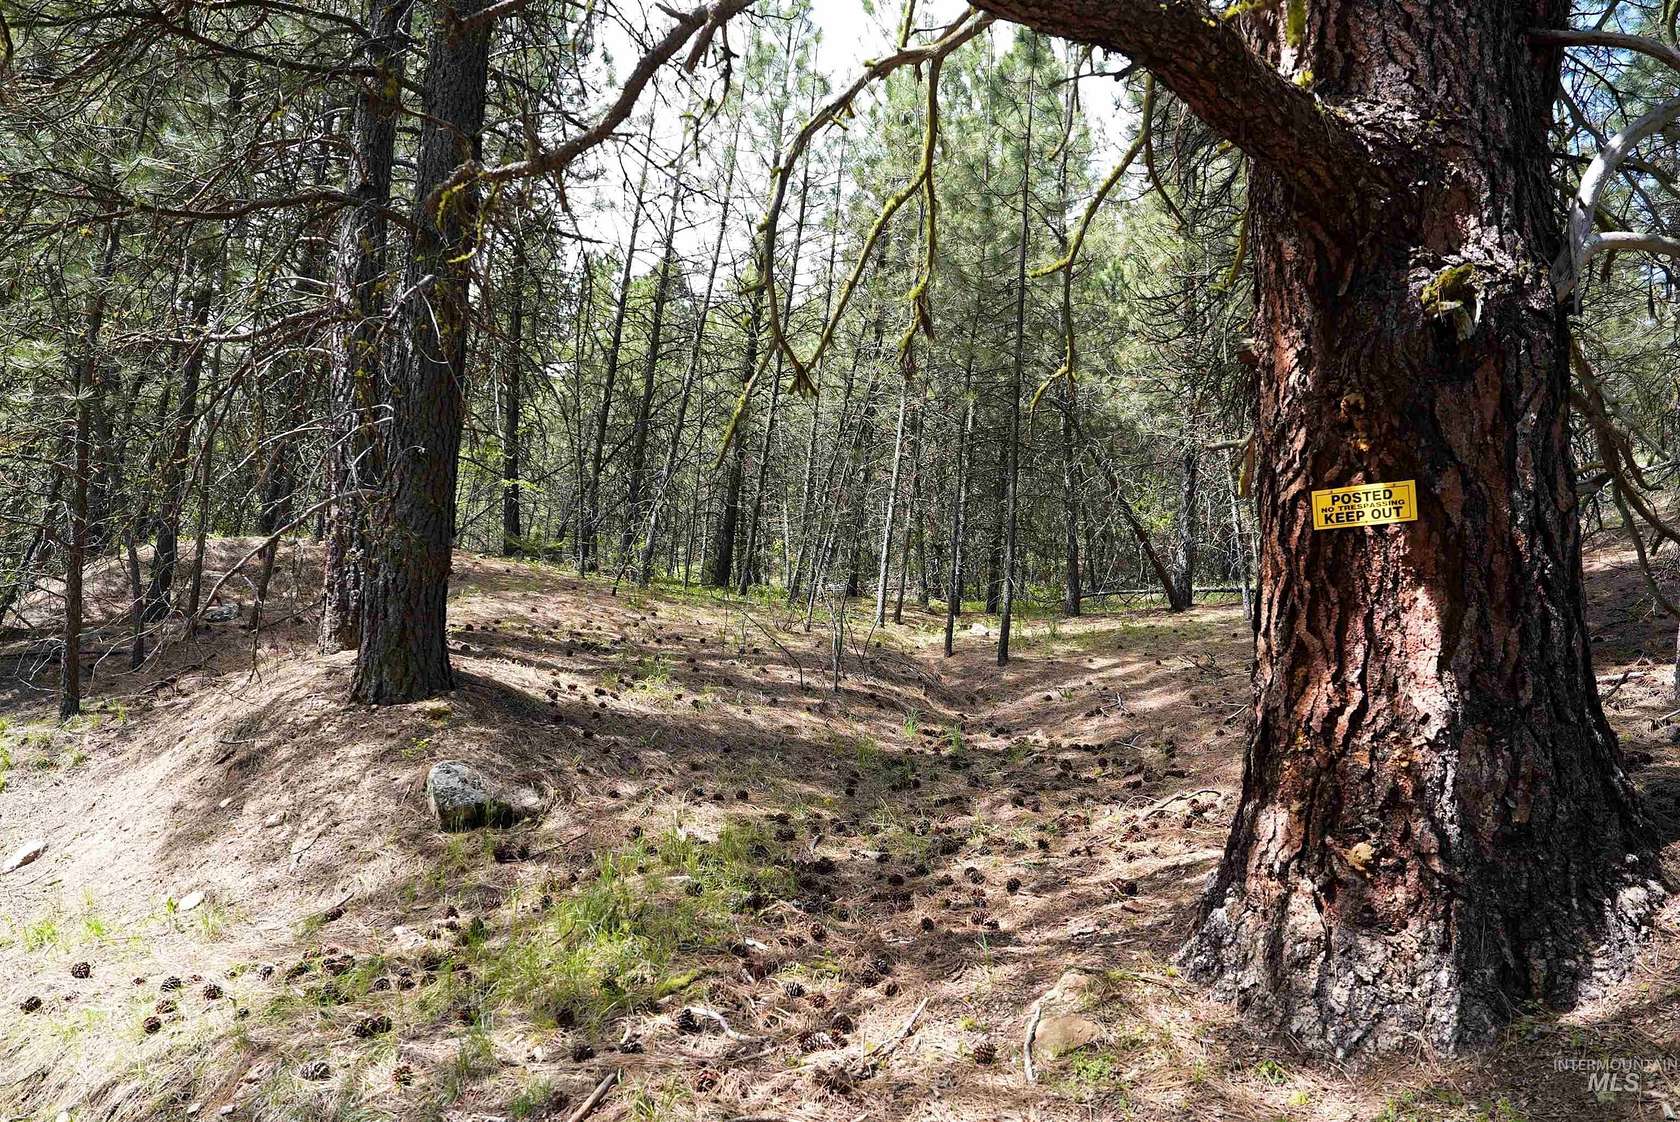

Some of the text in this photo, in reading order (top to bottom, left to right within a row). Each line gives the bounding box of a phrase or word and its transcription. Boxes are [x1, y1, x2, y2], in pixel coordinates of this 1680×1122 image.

[1331, 489, 1393, 506] POSTED
[1338, 499, 1405, 511] TRESPASSING
[1324, 506, 1403, 524] KEEP OUT
